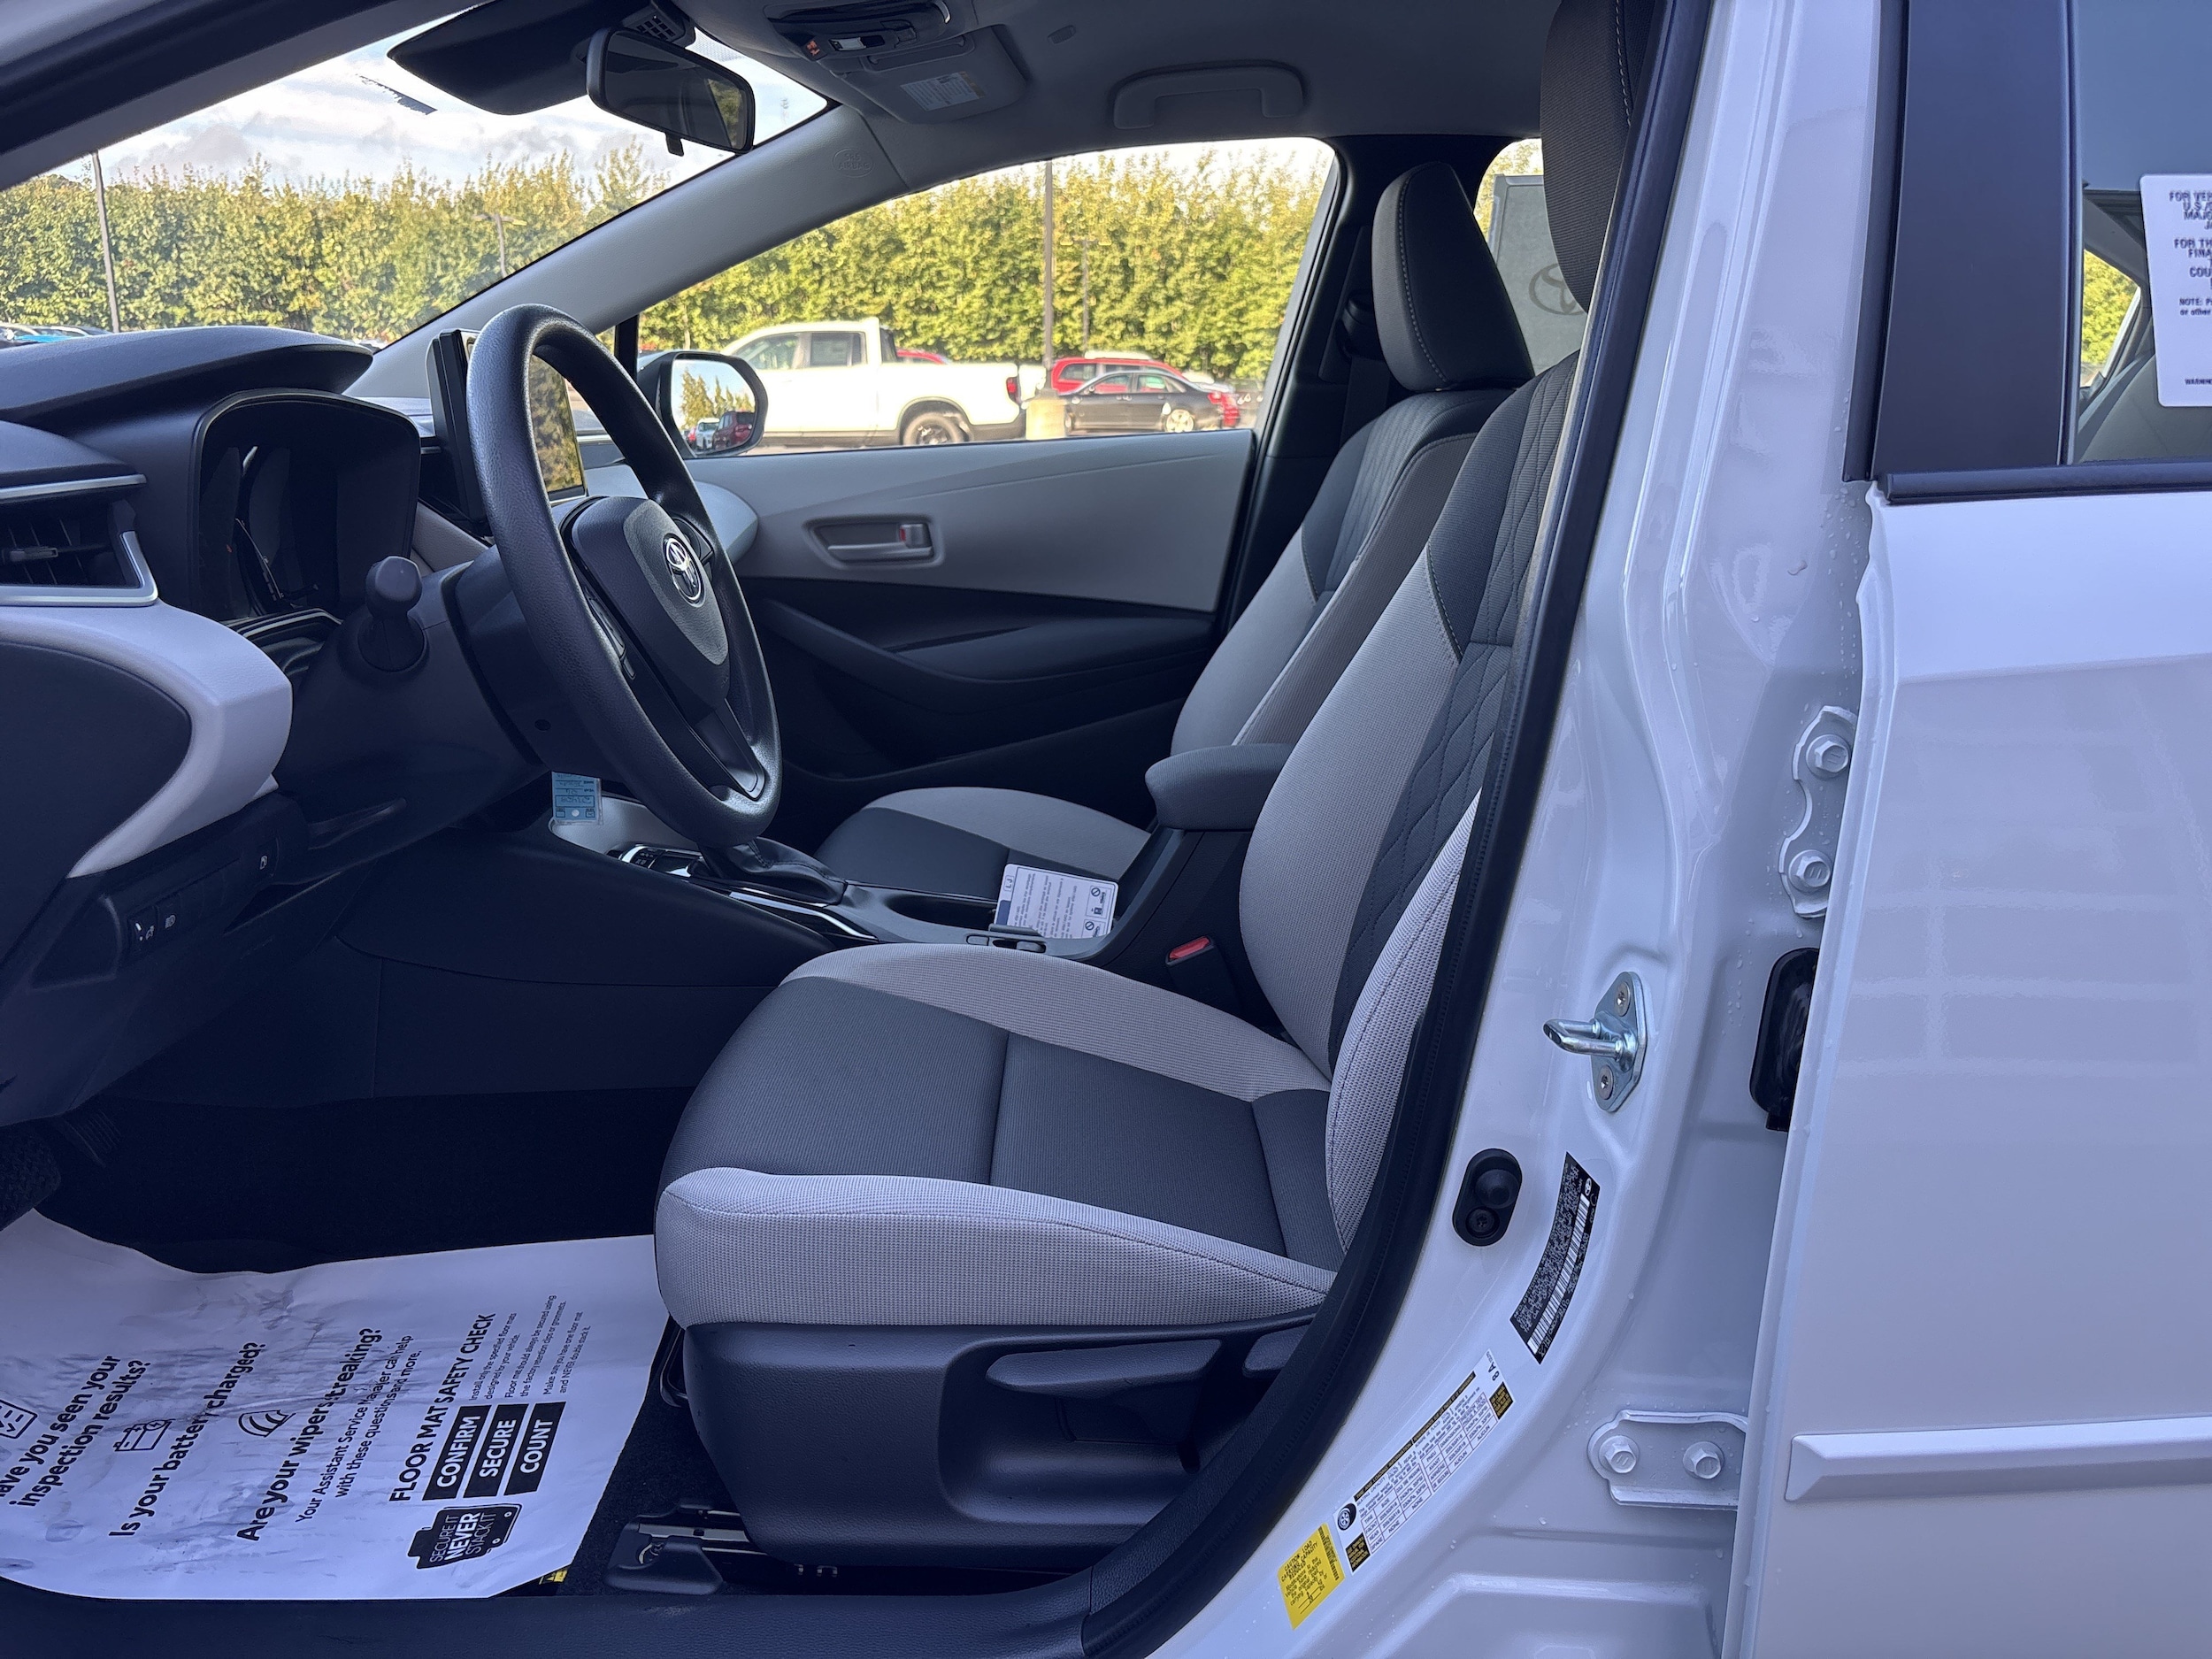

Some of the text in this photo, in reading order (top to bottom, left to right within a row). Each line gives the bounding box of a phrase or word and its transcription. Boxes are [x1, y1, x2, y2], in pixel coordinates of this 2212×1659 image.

[2170, 191, 2191, 202] FOR
[2174, 239, 2195, 249] FOR
[469, 1380, 483, 1401] Install
[504, 1380, 518, 1398] Floor
[520, 1385, 531, 1397] the
[543, 1376, 556, 1394] Make
[559, 1380, 569, 1393] and
[1488, 1362, 1496, 1373] A
[1492, 1371, 1500, 1381] 8
[0, 1356, 120, 1497] ave you seen your
[296, 1497, 322, 1522] Your
[312, 1446, 349, 1495] Assistant
[338, 1407, 368, 1448] Service
[390, 1336, 414, 1356] help
[389, 1313, 495, 1502] FLOOR MAT SAFETY CHECK
[9, 1360, 150, 1506] inspection results?
[108, 1522, 141, 1536] Is
[129, 1474, 170, 1517] your
[204, 1342, 265, 1409] charged?
[437, 1416, 481, 1486] CONFIRM
[480, 1419, 517, 1478] SECURE
[520, 1419, 553, 1473] COUNT
[237, 1506, 274, 1541] Are
[262, 1460, 299, 1503] your
[288, 1402, 334, 1458] wipers
[335, 1470, 357, 1498] with
[347, 1440, 372, 1469] these
[430, 1515, 458, 1563] SECURE IT
[444, 1512, 480, 1561] NEVER
[465, 1513, 496, 1555] STACK IT
